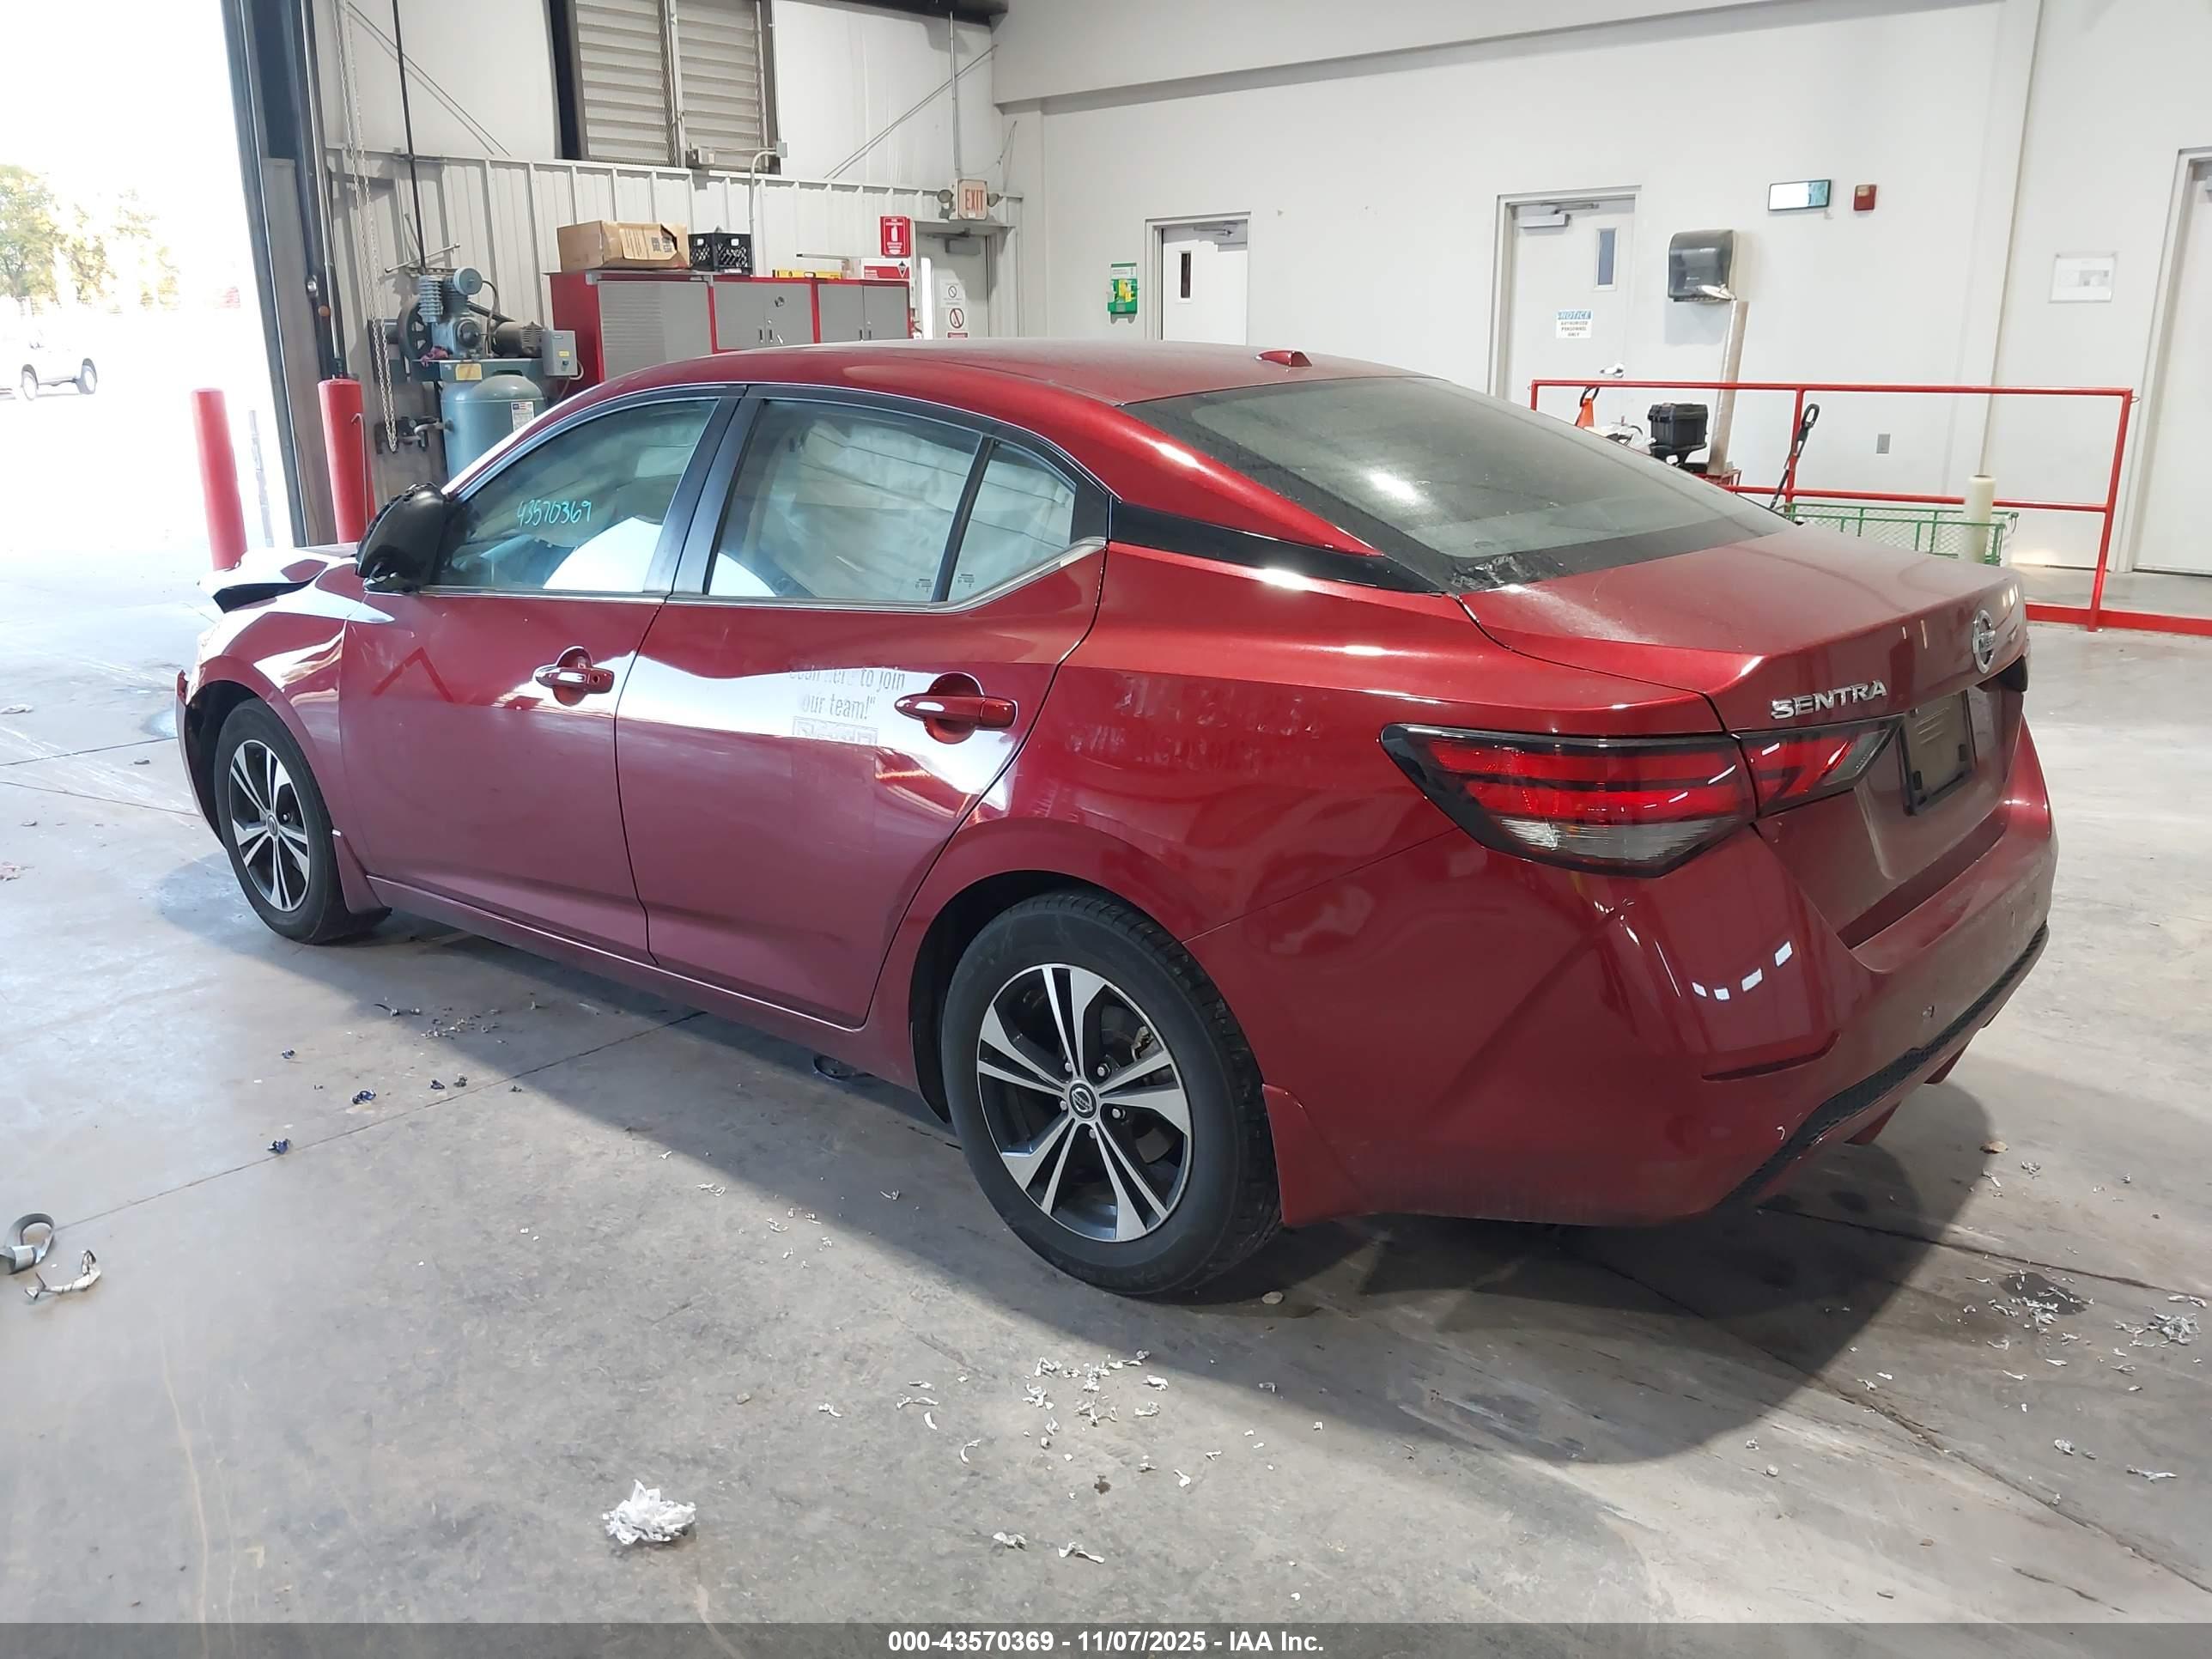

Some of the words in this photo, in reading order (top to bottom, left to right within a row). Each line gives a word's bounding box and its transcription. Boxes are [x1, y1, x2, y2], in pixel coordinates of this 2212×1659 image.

[965, 189, 984, 211] EXIT
[1559, 311, 1591, 319] NOTICE
[517, 500, 591, 527] 43570369
[860, 669, 874, 688] to
[876, 669, 906, 693] join
[803, 695, 825, 714] our
[1771, 680, 1888, 720] SENTRA
